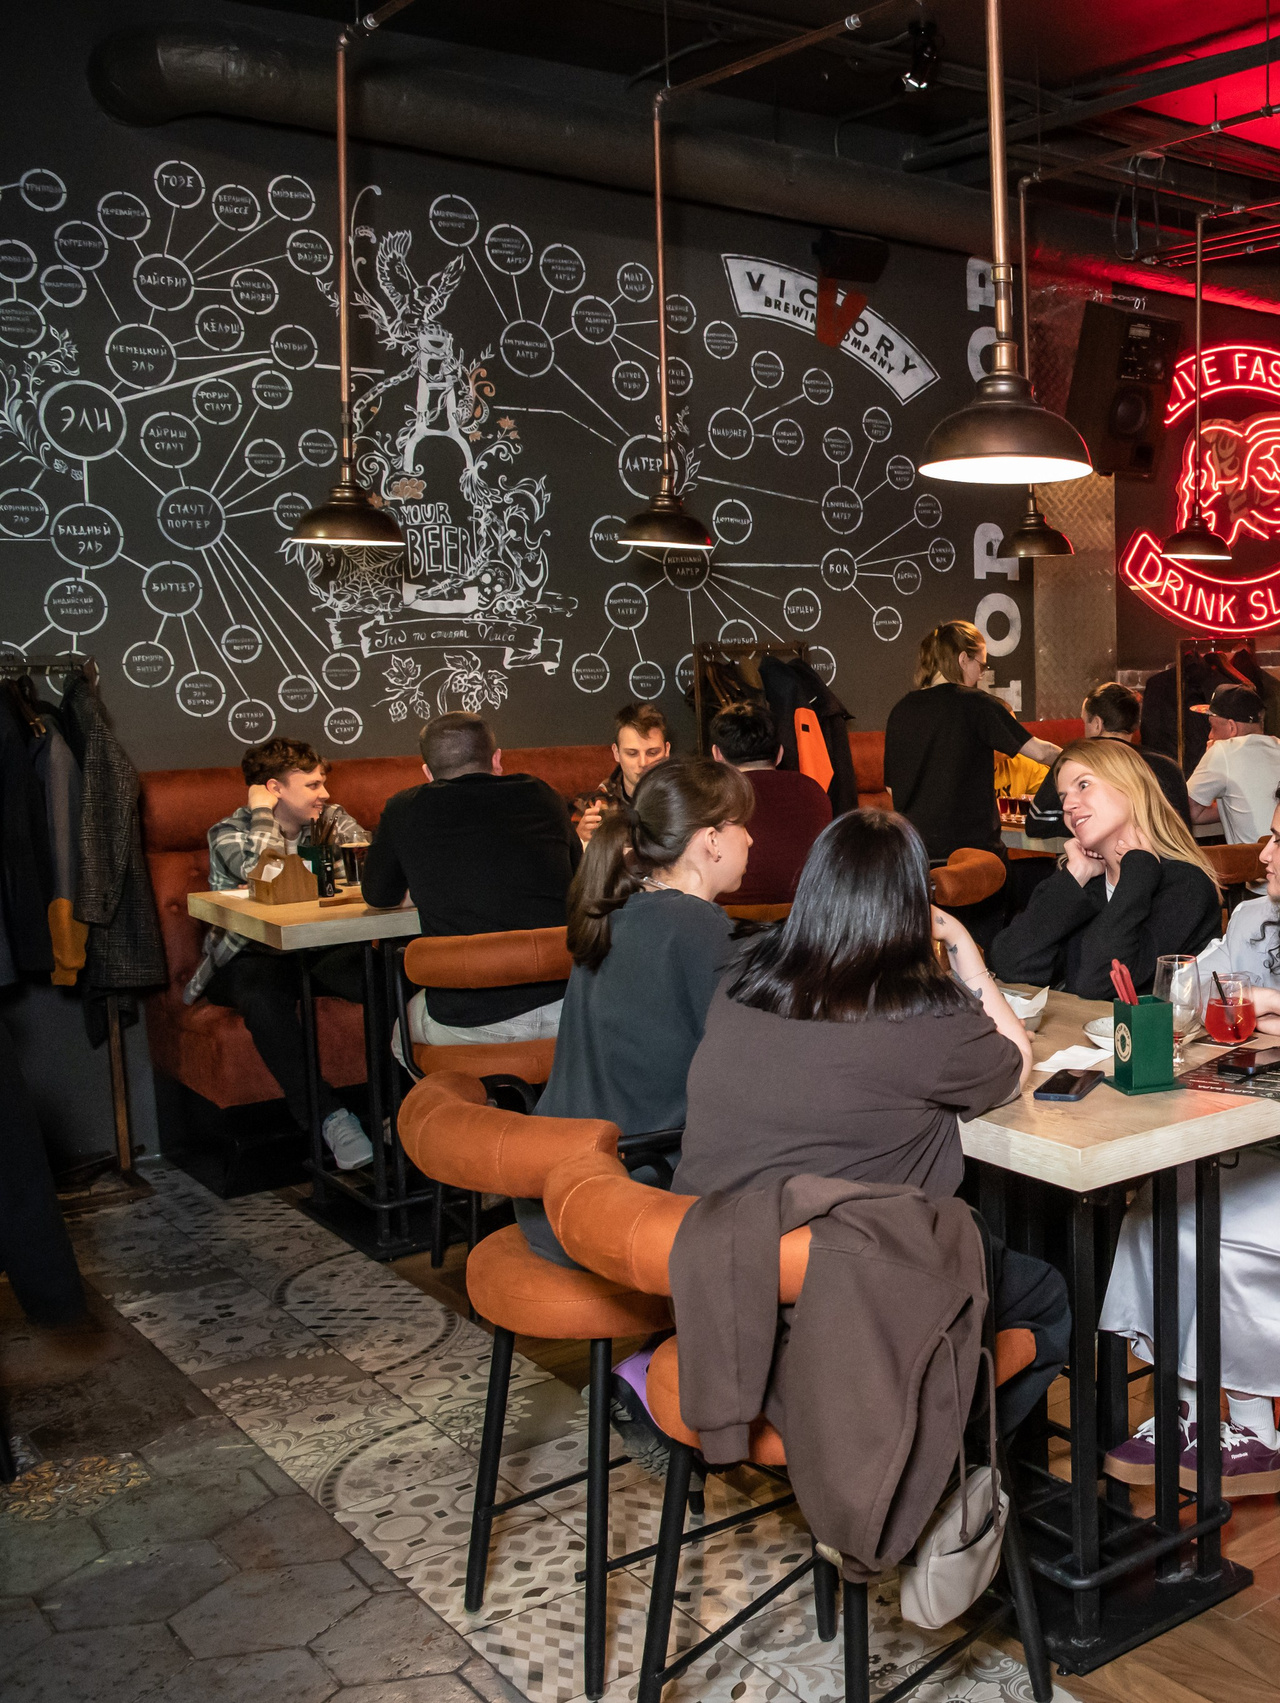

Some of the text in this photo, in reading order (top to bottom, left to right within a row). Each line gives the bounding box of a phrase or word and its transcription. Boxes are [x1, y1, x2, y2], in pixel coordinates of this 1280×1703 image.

[161, 173, 195, 188] ГОЗЕ
[139, 271, 188, 287] ВАЙСБИР
[745, 271, 917, 375] VICORY
[111, 343, 168, 357] НЕМЕЦКИЙ
[843, 331, 896, 375] OMPANY
[131, 359, 155, 372] ЭЛЬ
[204, 403, 233, 412] СТАУТ
[149, 427, 188, 439] АЙРИШ
[154, 442, 185, 452] СТАУТ
[625, 456, 663, 473] ЛАГЕР
[400, 501, 452, 525] YOUR
[57, 522, 111, 536] БЛЕДНЫЙ
[166, 519, 211, 530] ПОРТЕР
[78, 541, 103, 555] ЭЛЬ
[406, 525, 472, 579] BEER
[829, 563, 850, 576] БОК
[151, 582, 196, 593] БИТТЕР
[1138, 550, 1237, 624] DRINK
[786, 605, 815, 615] МЕРЦЕН
